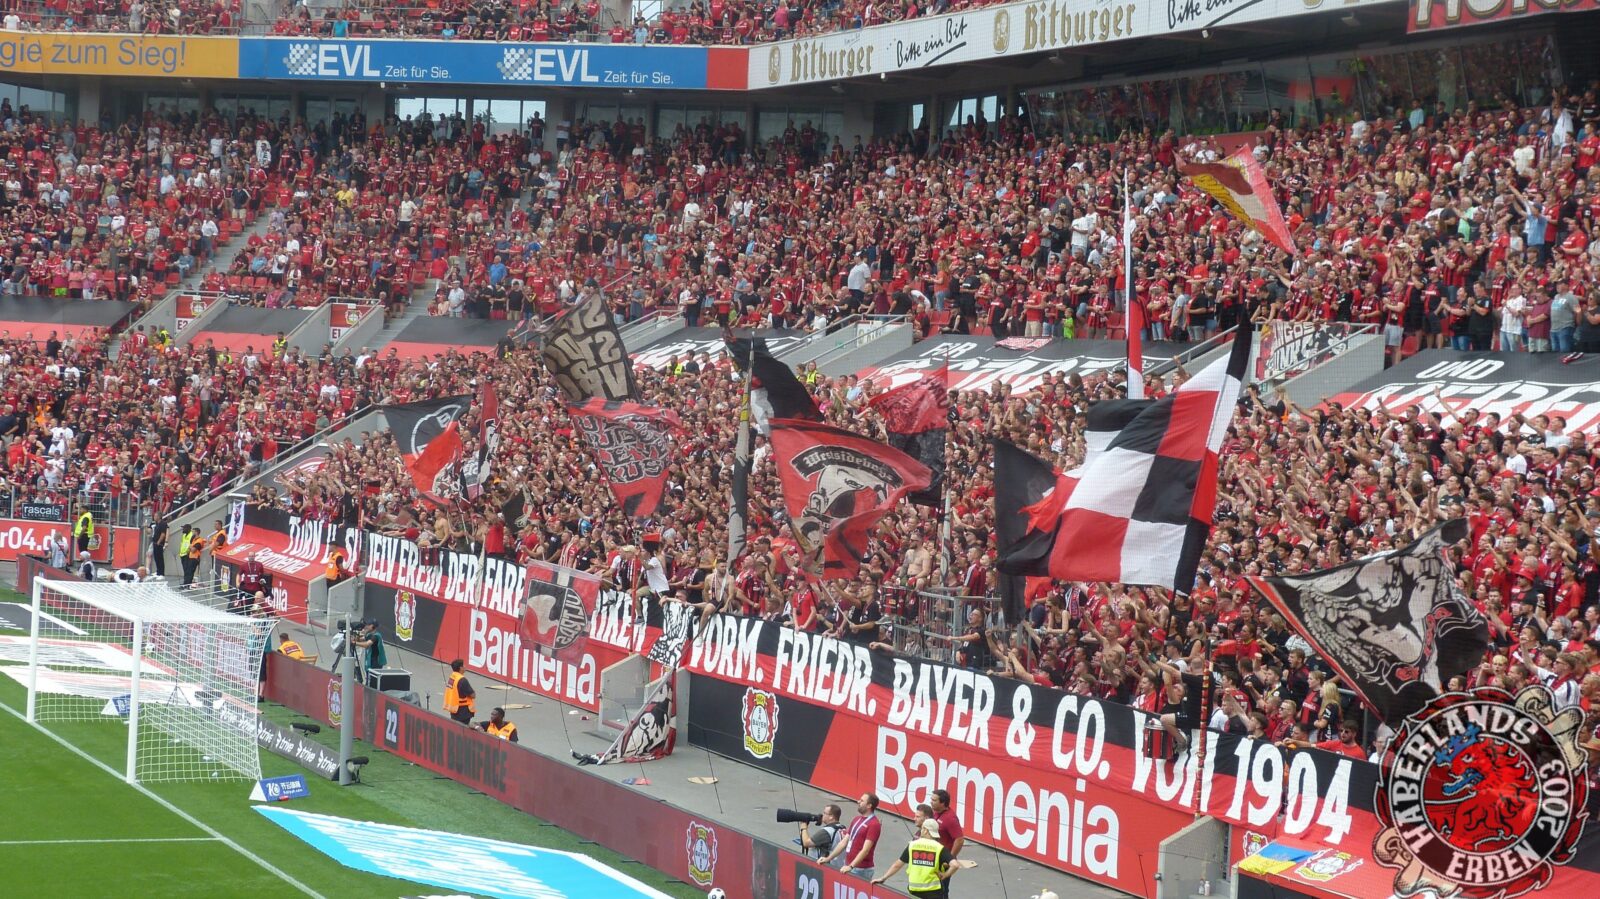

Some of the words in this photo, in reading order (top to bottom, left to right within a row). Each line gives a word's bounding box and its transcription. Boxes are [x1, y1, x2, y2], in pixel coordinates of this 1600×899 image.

[1024, 0, 1135, 50] Bitburger
[0, 39, 43, 66] gie
[51, 45, 107, 64] zum
[118, 39, 187, 73] Sieg!
[897, 40, 922, 67] Bitte
[923, 36, 944, 52] ein
[946, 18, 968, 43] Bit
[319, 44, 380, 77] EVL
[385, 65, 408, 79] Zeit
[411, 65, 428, 79] für
[430, 66, 452, 79] Sie.
[535, 48, 599, 82] EVL
[604, 69, 627, 84] Zeit
[631, 69, 649, 84] für
[651, 70, 674, 84] Sie.
[790, 41, 874, 83] Bitburger
[177, 320, 189, 330] E2
[332, 329, 341, 339] E1
[1416, 358, 1505, 380] UND
[24, 505, 60, 516] rascals
[445, 552, 479, 604] DER
[690, 613, 764, 683] VORM.
[773, 627, 877, 716] FRIEDR.
[888, 658, 995, 750] BAYER
[1006, 684, 1036, 761] &
[1052, 694, 1111, 781] CO.
[1225, 738, 1353, 845] 1904
[386, 708, 398, 744] 22
[404, 712, 445, 766] VICTOR
[447, 730, 508, 793] BONIFACE
[876, 726, 1120, 879] Barmenia
